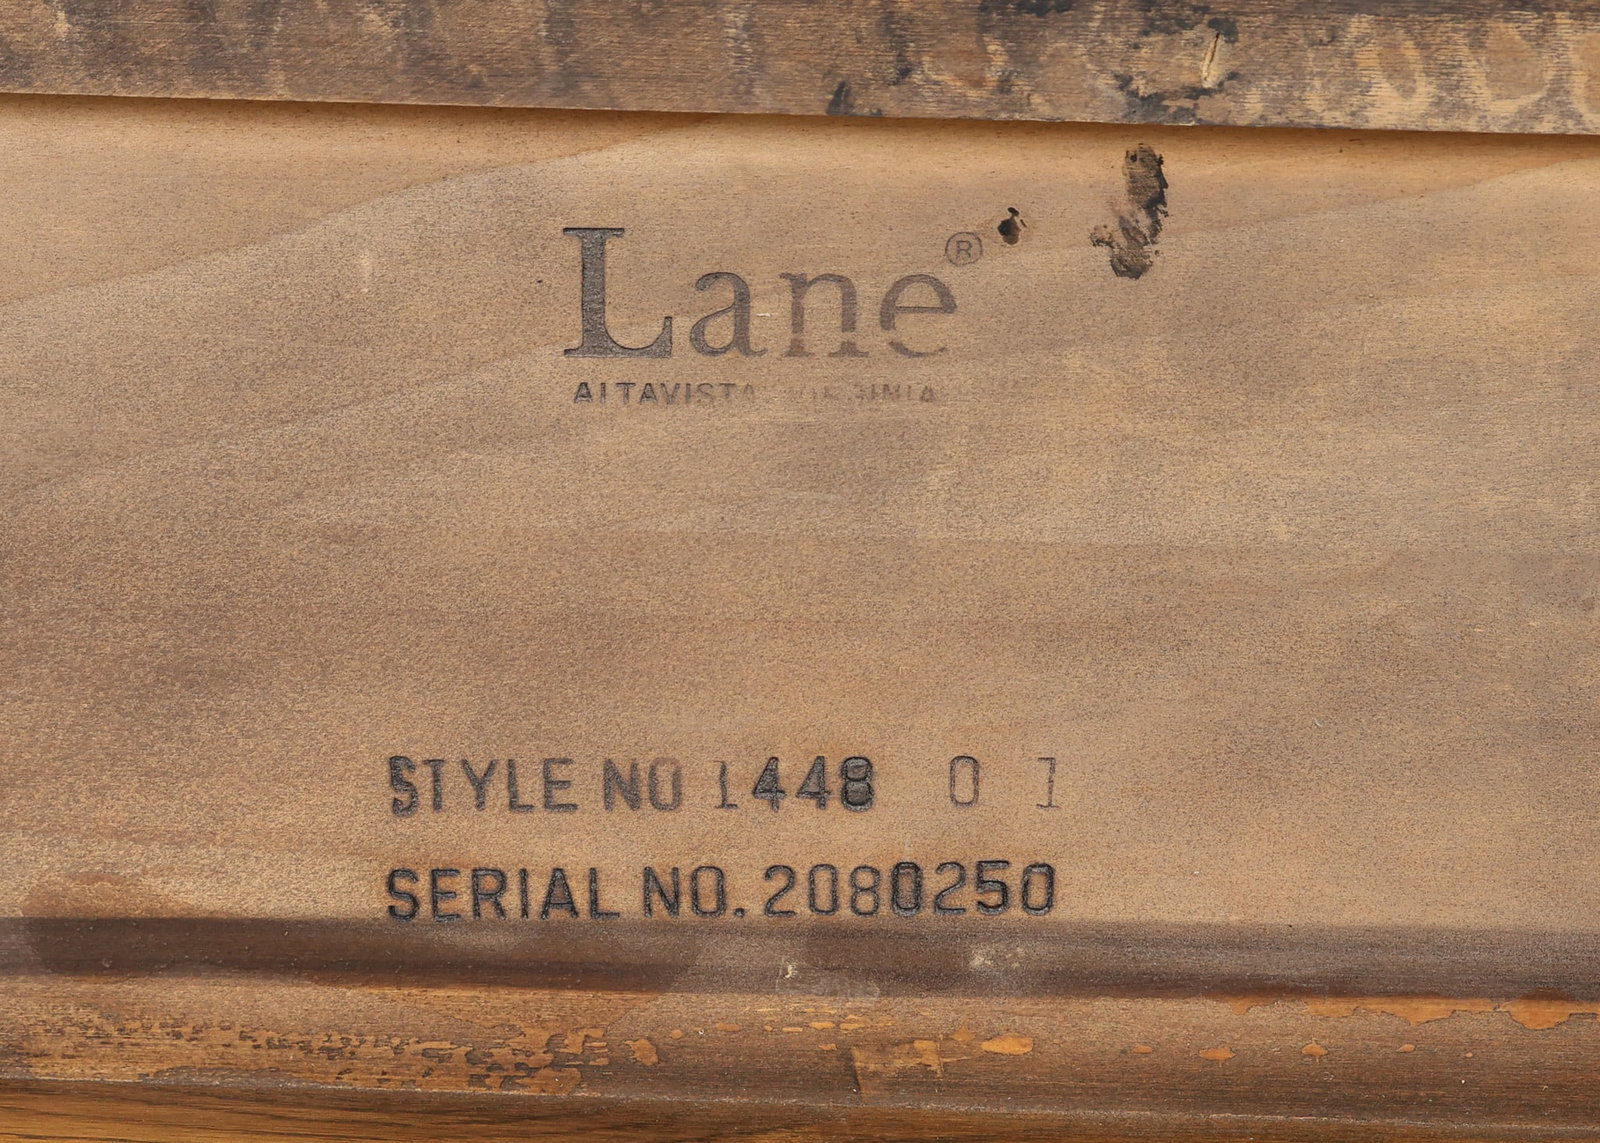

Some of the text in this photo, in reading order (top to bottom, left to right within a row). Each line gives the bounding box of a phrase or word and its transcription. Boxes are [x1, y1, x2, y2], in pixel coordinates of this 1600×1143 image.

[562, 226, 958, 359] Lane
[389, 755, 579, 817] STYLE
[603, 758, 682, 812] NO
[708, 755, 875, 812] 1448
[387, 860, 1056, 923] SERIAL NO. 2080250
